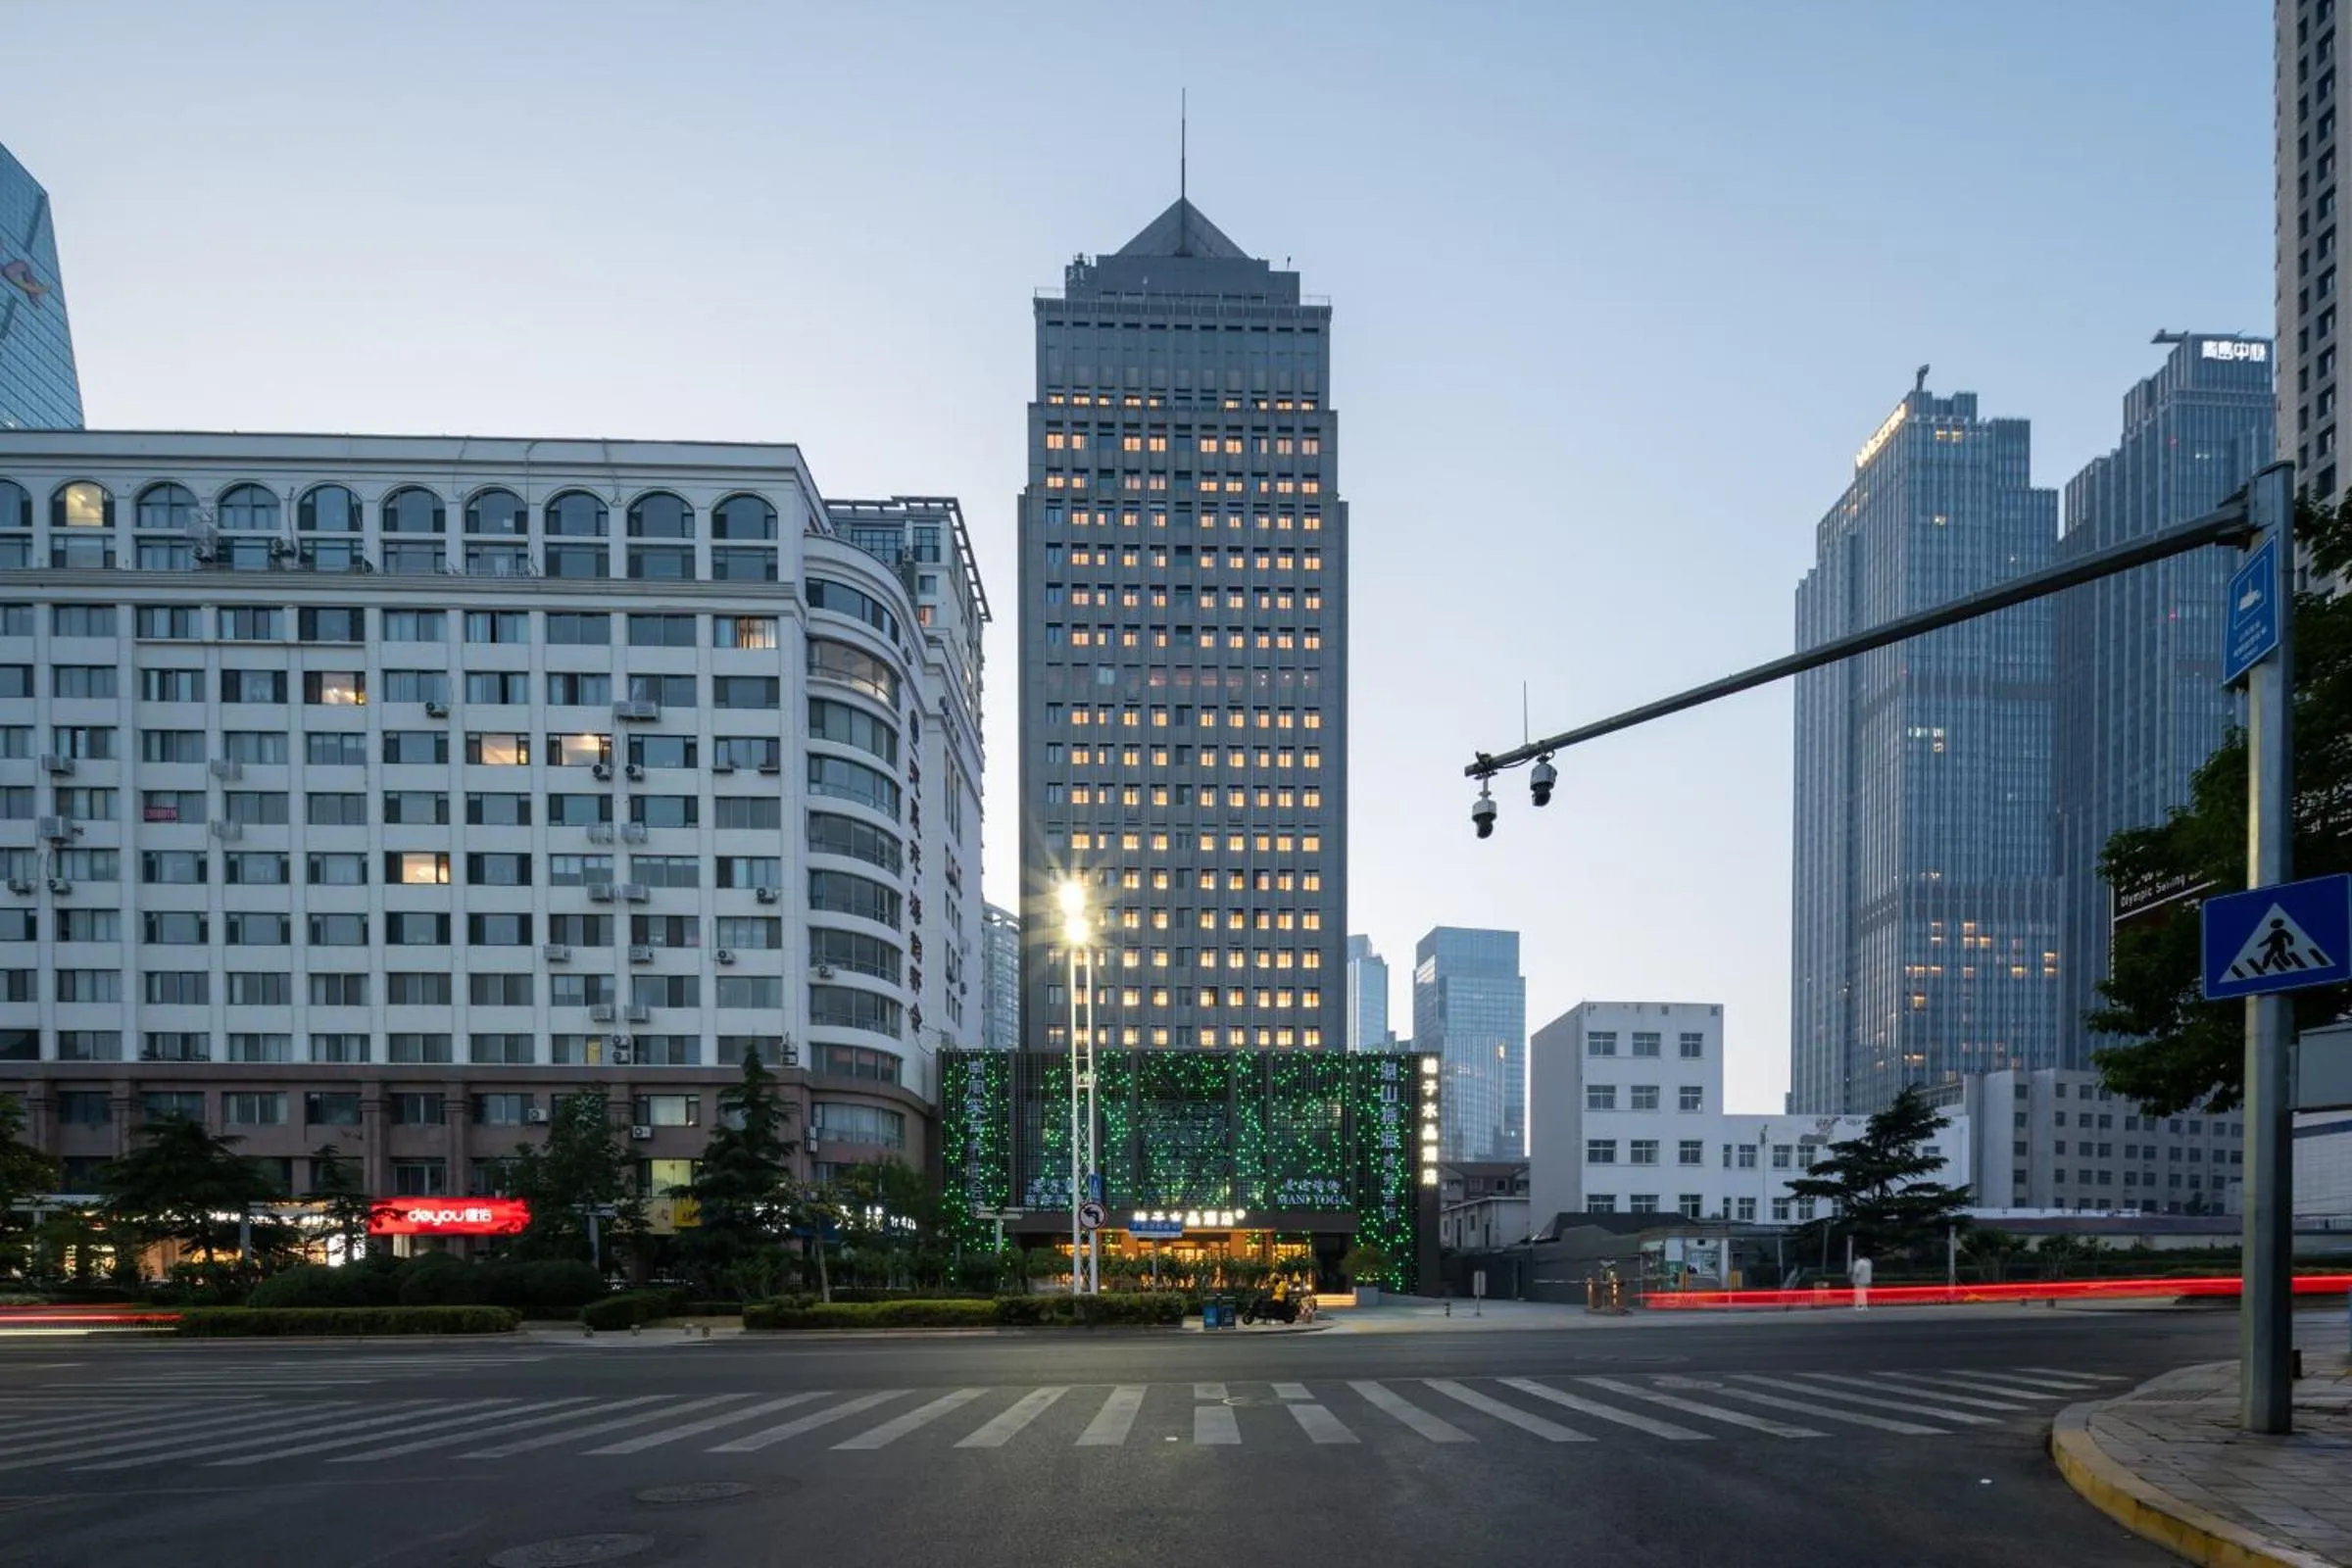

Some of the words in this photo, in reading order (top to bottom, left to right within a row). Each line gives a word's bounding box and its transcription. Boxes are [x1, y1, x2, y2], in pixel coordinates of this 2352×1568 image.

[2119, 886, 2153, 907] Olympic
[2155, 873, 2186, 894] Sailing
[1314, 1195, 1347, 1205] YOGA
[408, 1207, 464, 1225] deyou
